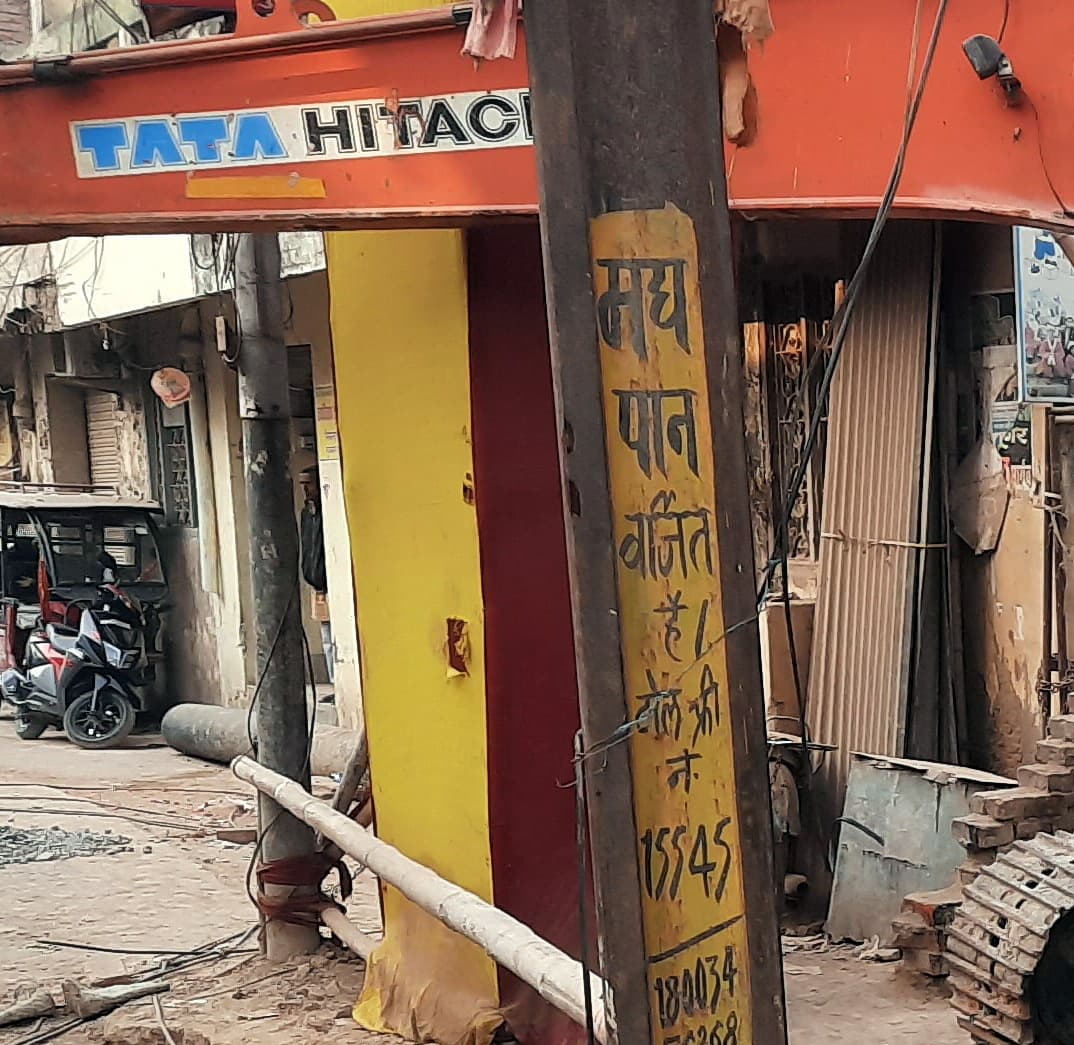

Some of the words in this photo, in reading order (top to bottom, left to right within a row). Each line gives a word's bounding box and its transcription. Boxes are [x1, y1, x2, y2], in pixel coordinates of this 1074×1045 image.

[77, 113, 288, 170] TATA
[302, 93, 533, 155] HITAC
[611, 389, 697, 480] पान
[619, 490, 711, 580] वर्जित
[641, 816, 731, 903] 15545
[653, 946, 738, 1029] 180034
